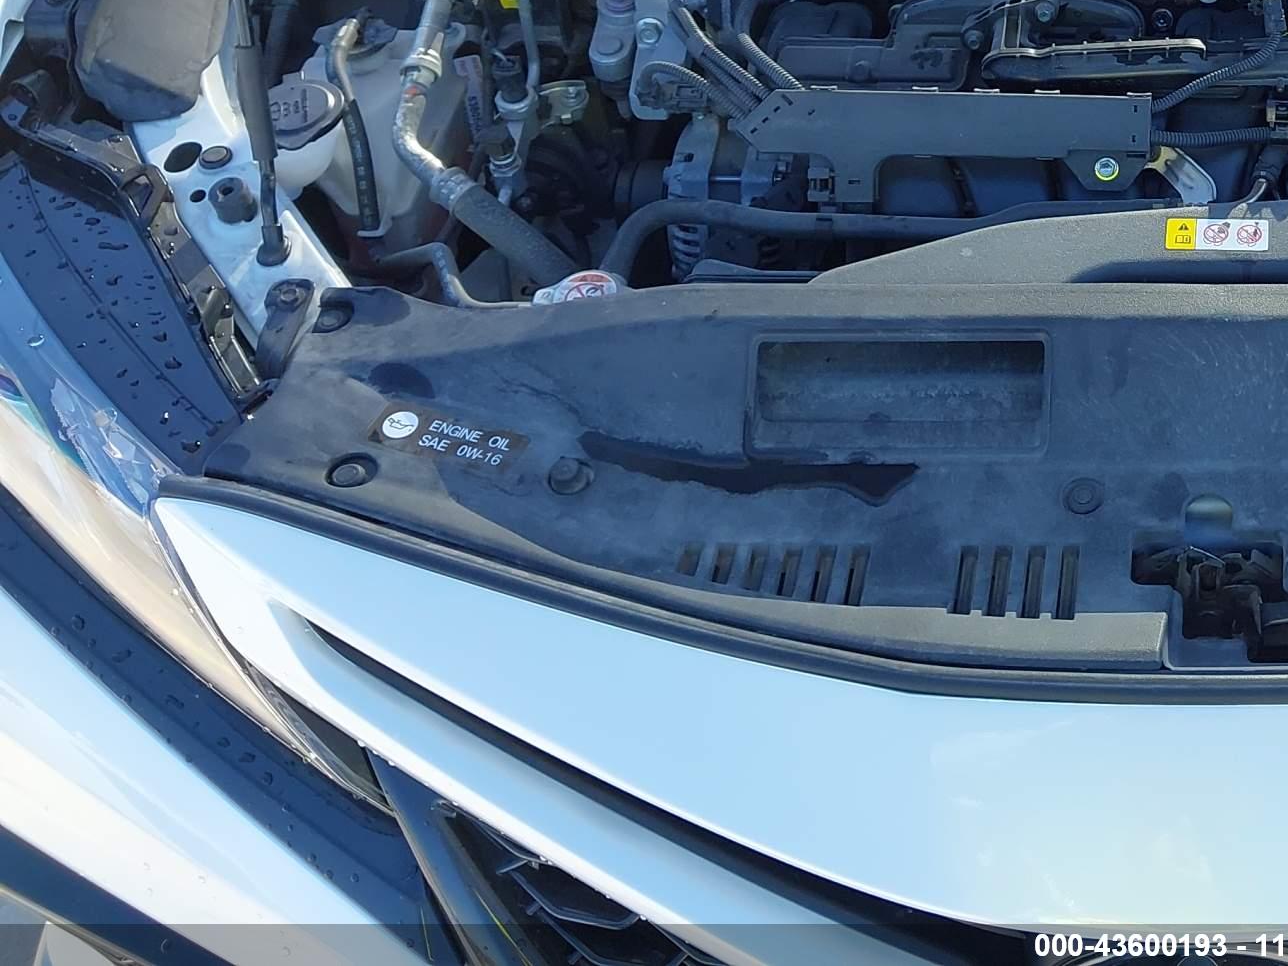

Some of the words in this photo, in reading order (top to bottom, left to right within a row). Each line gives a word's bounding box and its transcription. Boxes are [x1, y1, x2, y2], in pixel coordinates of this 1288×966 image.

[418, 434, 450, 451] SAE
[456, 444, 503, 466] 0W-16
[428, 420, 483, 442] ENGINE
[488, 436, 511, 451] OIL
